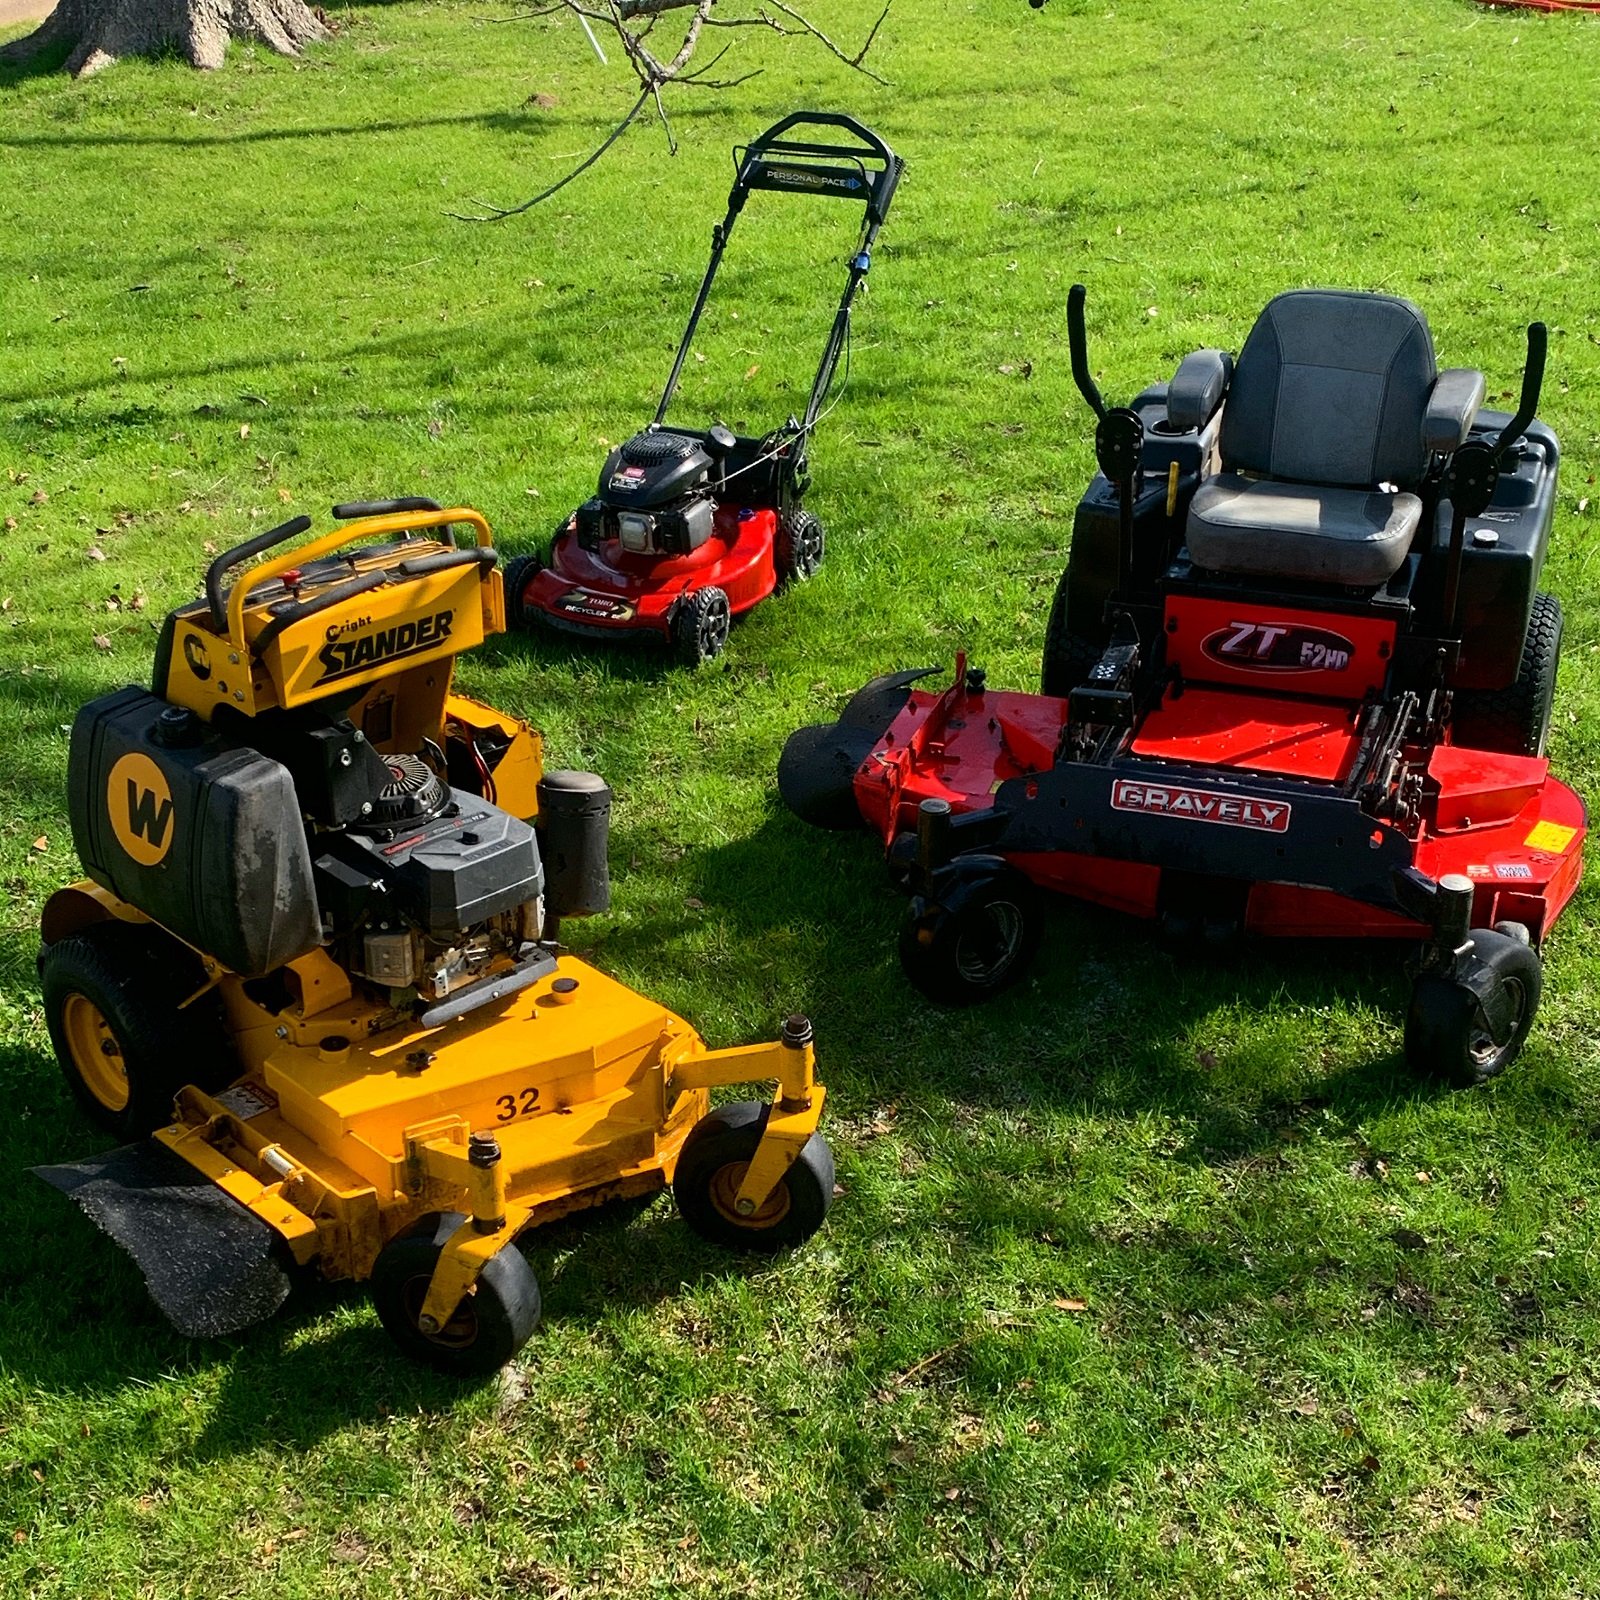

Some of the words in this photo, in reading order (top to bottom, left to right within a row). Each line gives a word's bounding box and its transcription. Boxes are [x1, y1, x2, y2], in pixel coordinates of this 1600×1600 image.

[766, 170, 818, 184] PERSONAL
[821, 177, 846, 187] PACE
[565, 604, 608, 618] RECYCLER
[589, 598, 614, 607] TORO
[318, 609, 454, 678] STANDER
[325, 615, 372, 642] Wright
[1220, 621, 1288, 657] ZT
[1300, 641, 1349, 670] 52HD
[127, 777, 174, 849] W
[1118, 784, 1285, 827] GRAVELY
[495, 1087, 542, 1122] 32
